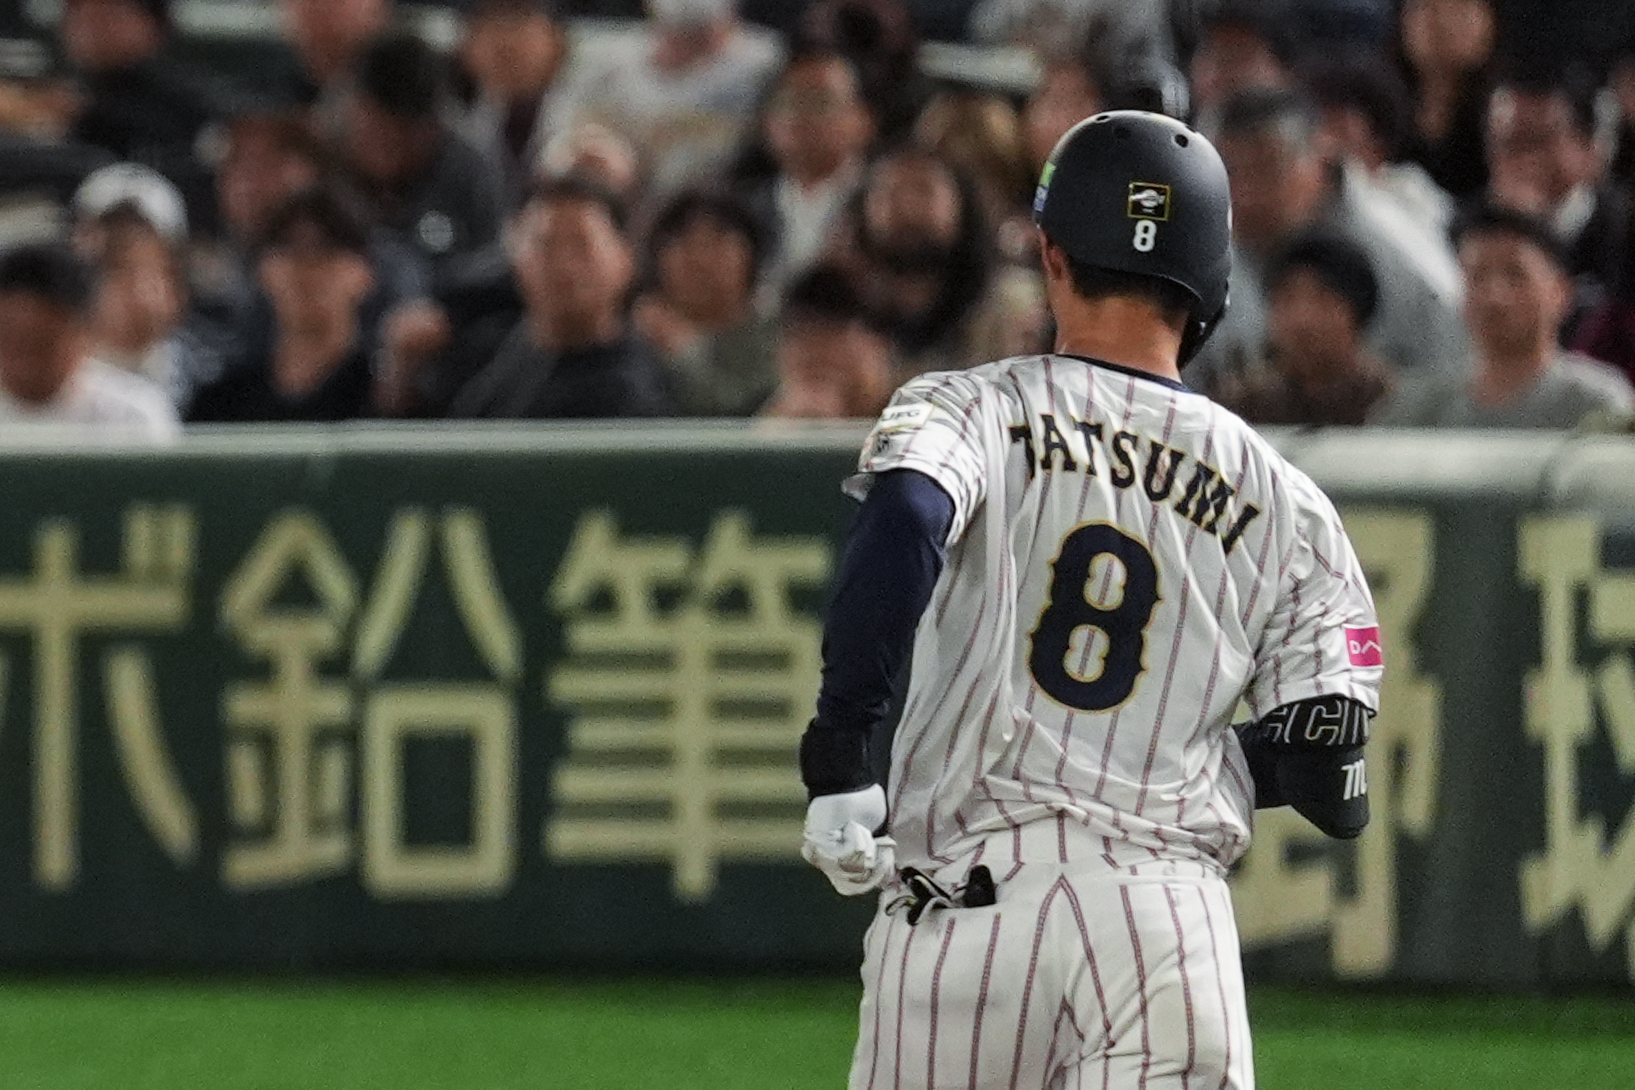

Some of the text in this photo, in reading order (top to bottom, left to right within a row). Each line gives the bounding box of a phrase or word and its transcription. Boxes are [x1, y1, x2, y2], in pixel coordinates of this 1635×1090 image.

[1133, 219, 1158, 253] 8
[1009, 413, 1260, 554] TATSUMI
[1027, 518, 1165, 714] 8
